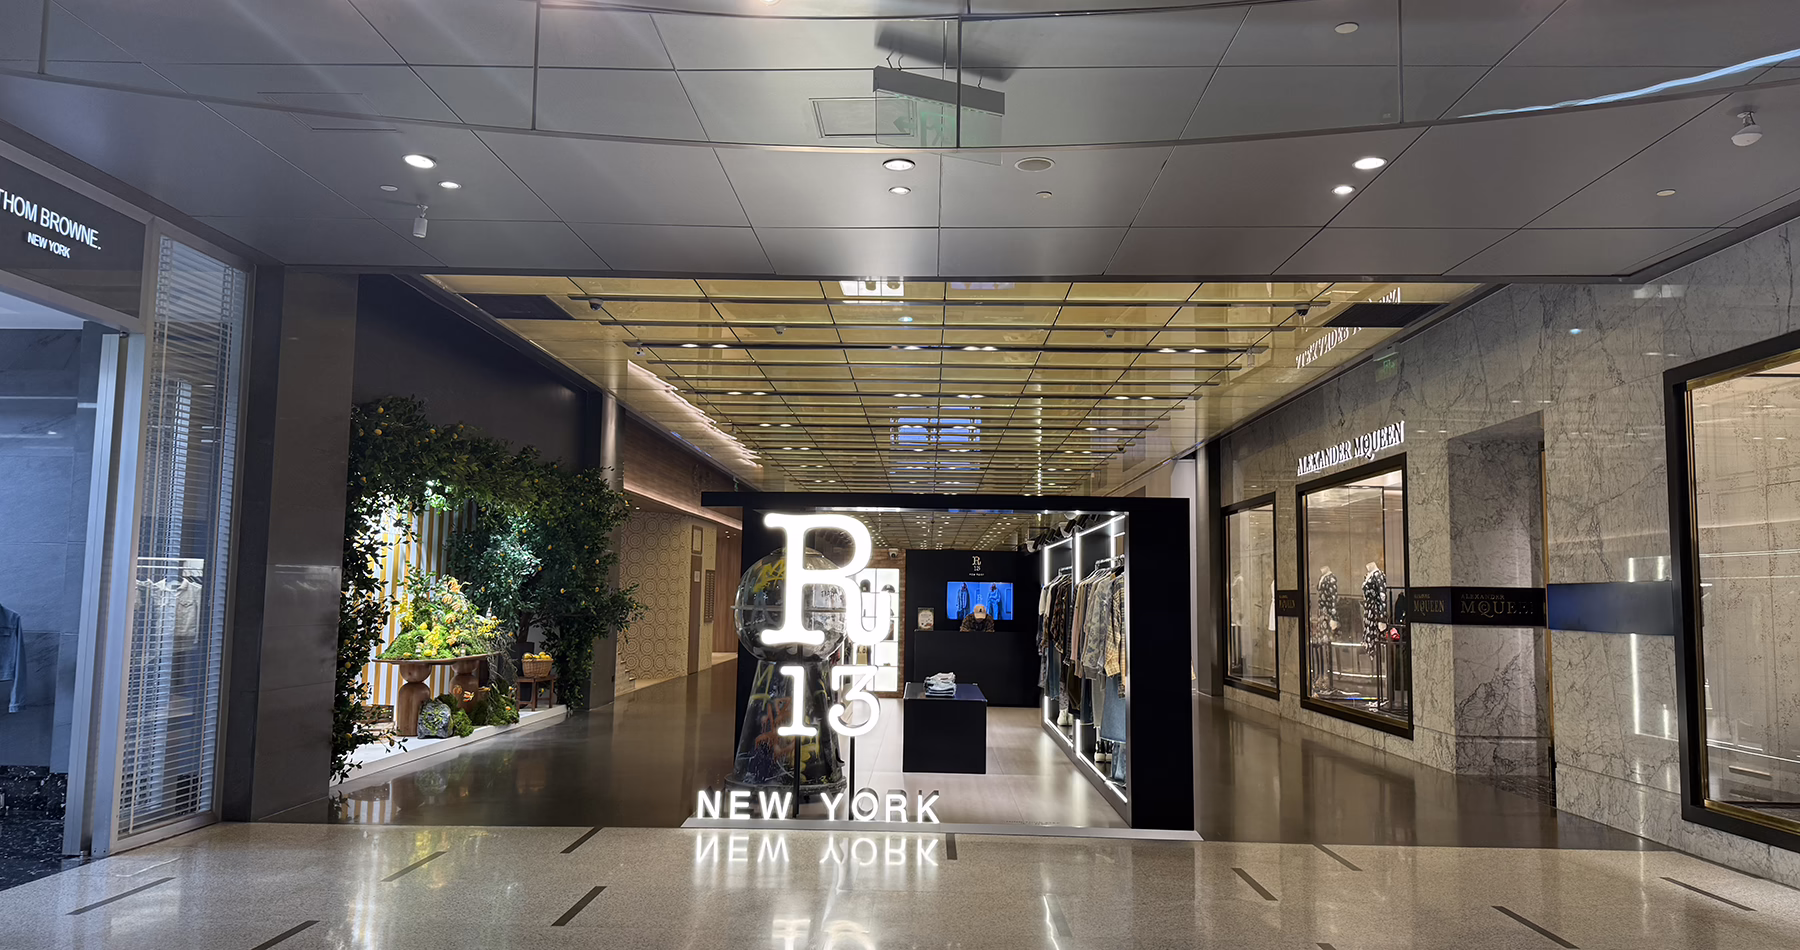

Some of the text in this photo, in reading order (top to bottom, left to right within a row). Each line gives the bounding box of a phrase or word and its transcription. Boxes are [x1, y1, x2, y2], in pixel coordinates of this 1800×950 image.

[27, 232, 71, 259] NEW YORK
[40, 207, 101, 250] BROWNE.
[1297, 440, 1353, 476] ALEXANDER
[778, 665, 881, 737] 13
[697, 790, 940, 824] NEW YORK
